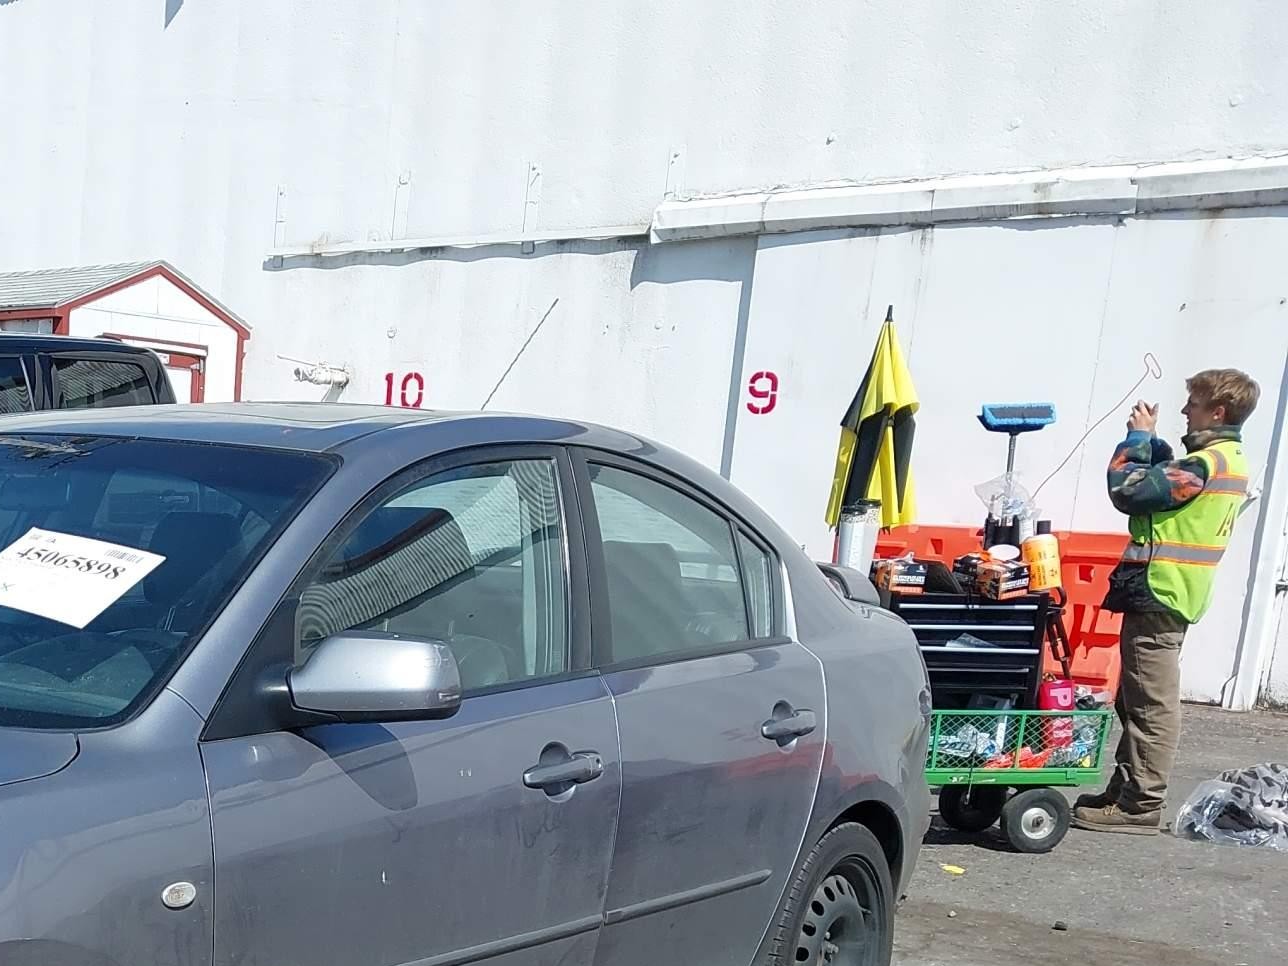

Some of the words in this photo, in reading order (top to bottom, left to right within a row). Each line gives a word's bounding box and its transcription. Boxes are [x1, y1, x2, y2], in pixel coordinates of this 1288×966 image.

[384, 372, 424, 408] 10
[746, 371, 778, 415] 9
[16, 545, 126, 580] 45065898
